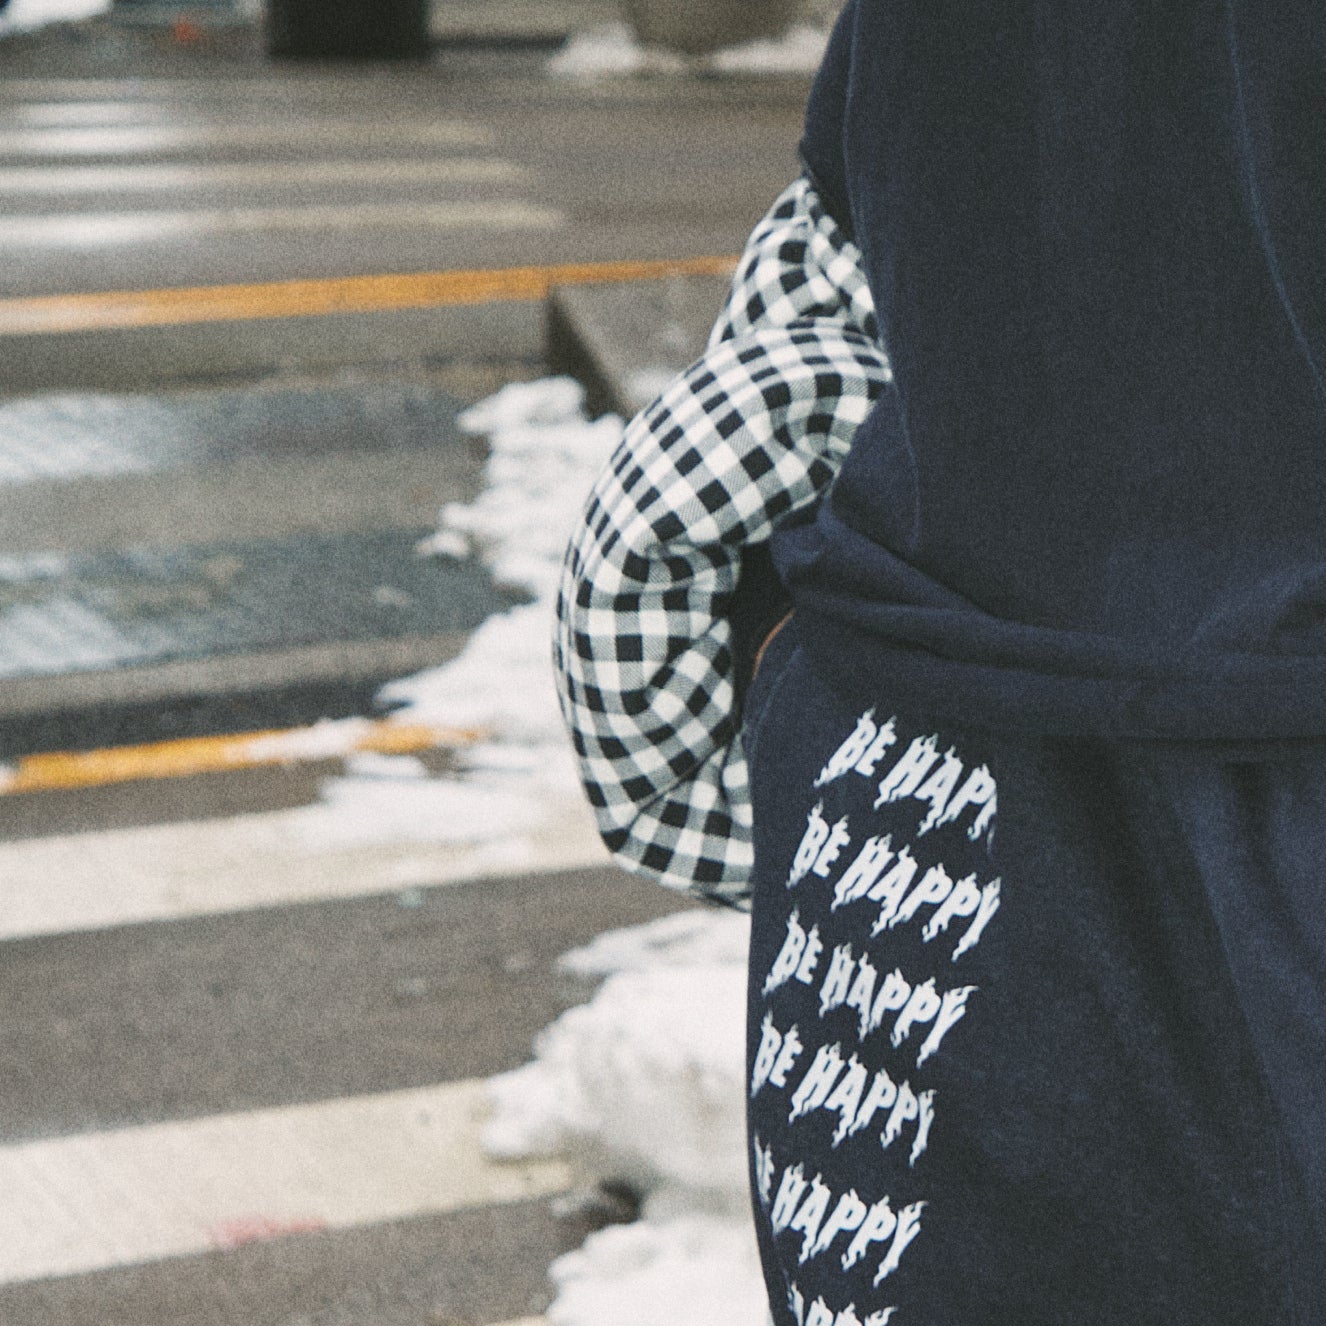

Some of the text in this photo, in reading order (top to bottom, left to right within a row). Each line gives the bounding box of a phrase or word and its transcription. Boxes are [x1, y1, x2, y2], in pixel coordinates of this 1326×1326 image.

[814, 708, 897, 788] BE
[786, 799, 1002, 962] BE HAPPY
[762, 905, 979, 1069] BE HAPPY
[751, 1009, 937, 1168] BE HAPPY
[770, 1161, 929, 1289] HAPPY
